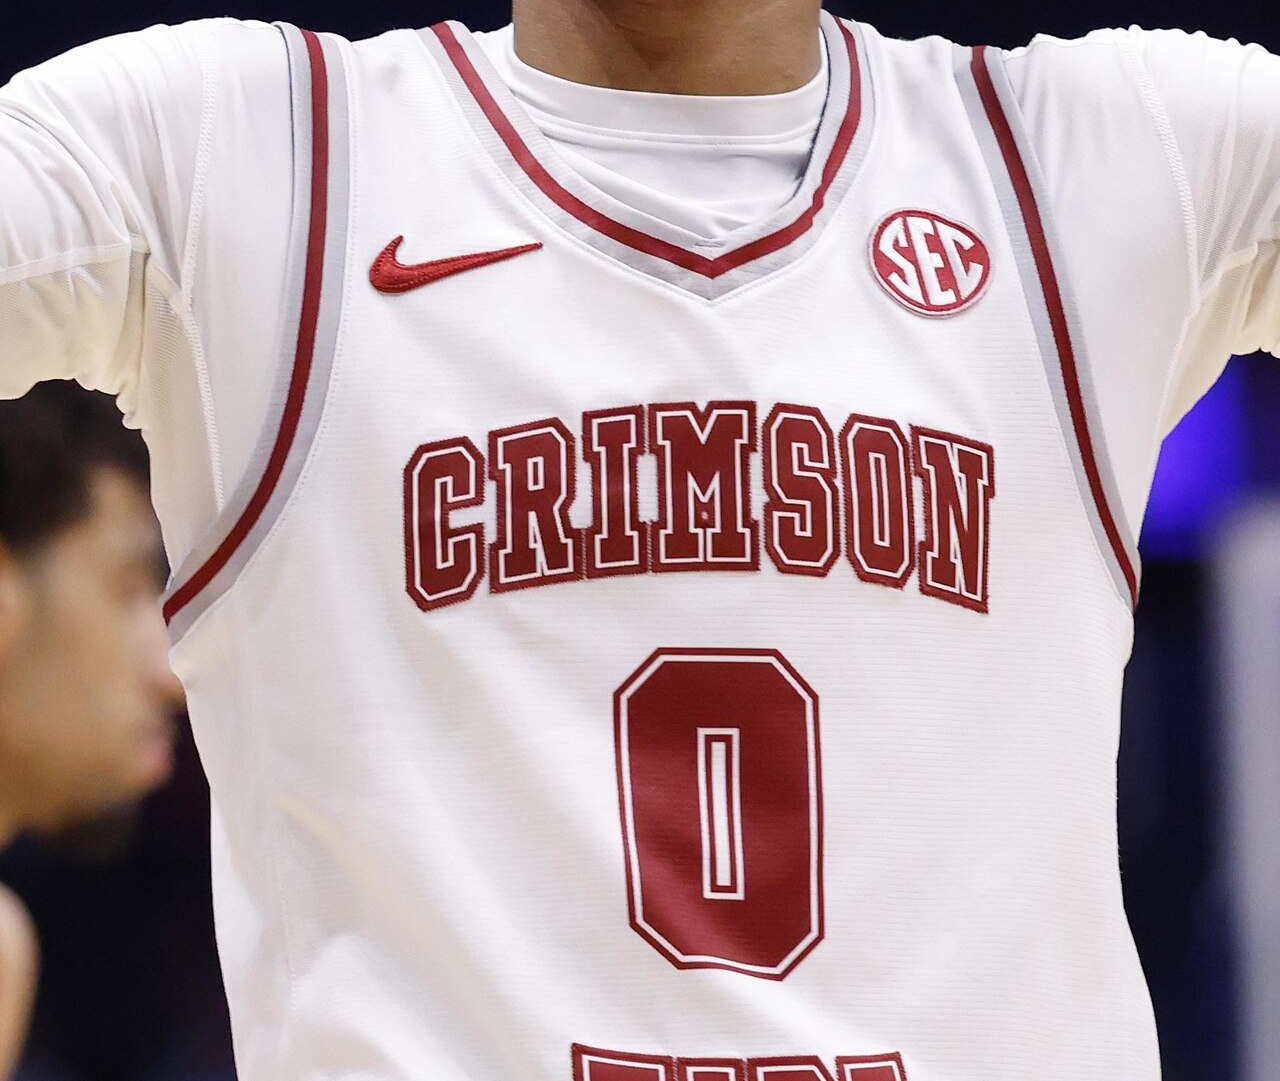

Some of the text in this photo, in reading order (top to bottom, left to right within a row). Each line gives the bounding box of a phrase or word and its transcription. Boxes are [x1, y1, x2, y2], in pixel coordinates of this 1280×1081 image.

[878, 216, 985, 306] SEC
[403, 399, 995, 614] CRIMSON
[613, 647, 825, 981] 0
